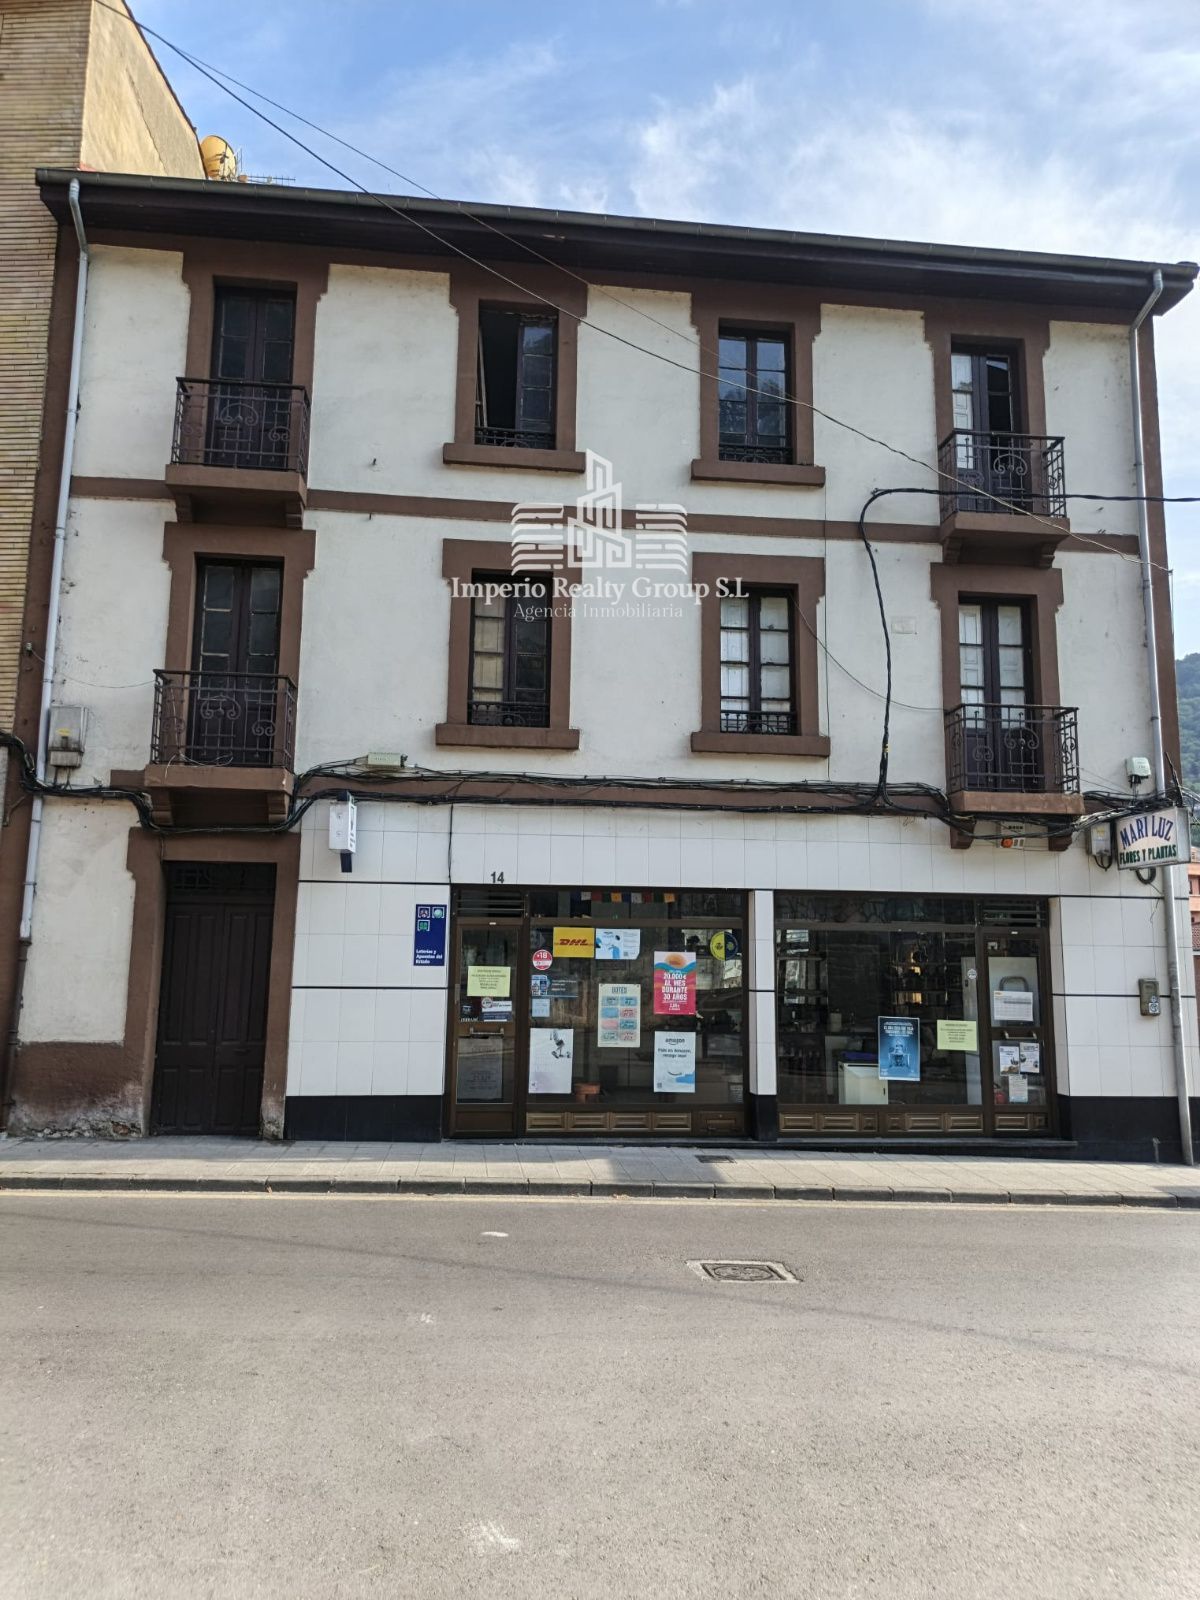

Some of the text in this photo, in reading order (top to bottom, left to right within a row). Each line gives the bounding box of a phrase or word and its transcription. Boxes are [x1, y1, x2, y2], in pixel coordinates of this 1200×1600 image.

[1120, 815, 1174, 849] MARI LUZ
[1119, 844, 1177, 865] FLORES Y PLANTAS
[491, 871, 505, 884] 14
[559, 938, 588, 946] DHL
